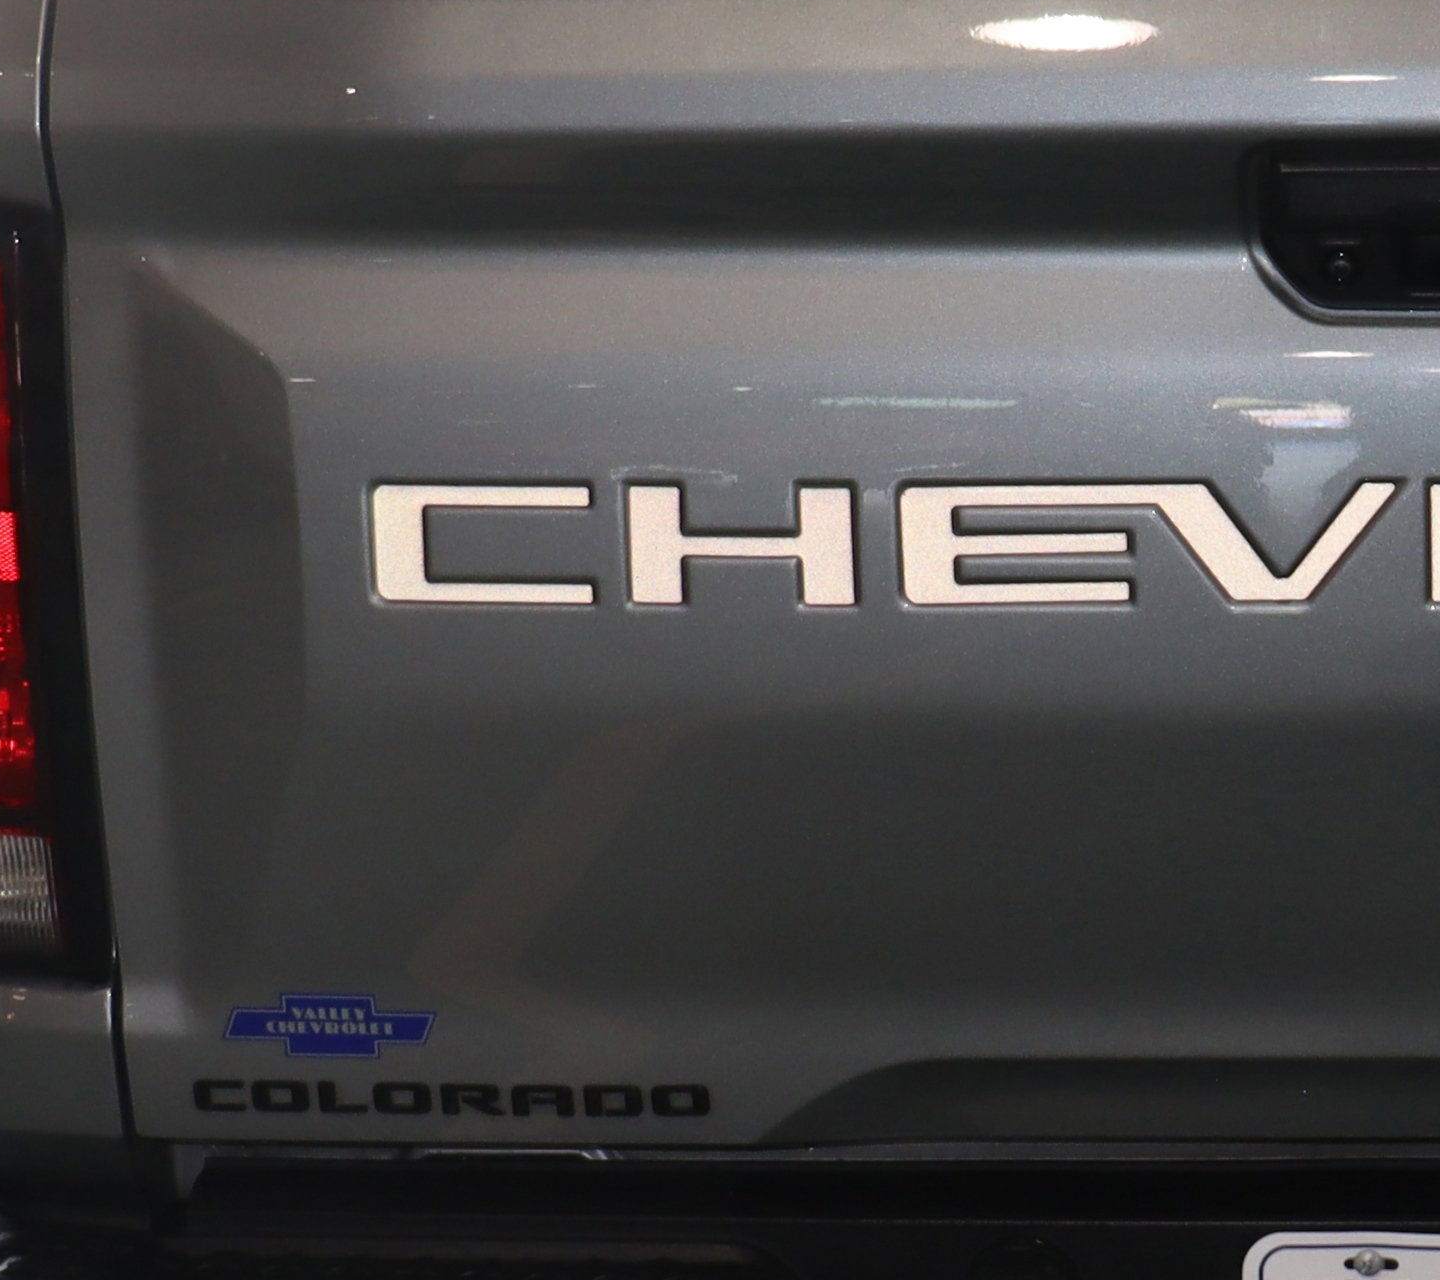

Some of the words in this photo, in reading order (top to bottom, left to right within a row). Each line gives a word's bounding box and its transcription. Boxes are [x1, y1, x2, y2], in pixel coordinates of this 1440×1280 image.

[290, 1006, 367, 1021] VALLEY
[265, 1020, 394, 1035] CHEVROLET
[192, 1079, 711, 1118] COLORADO
